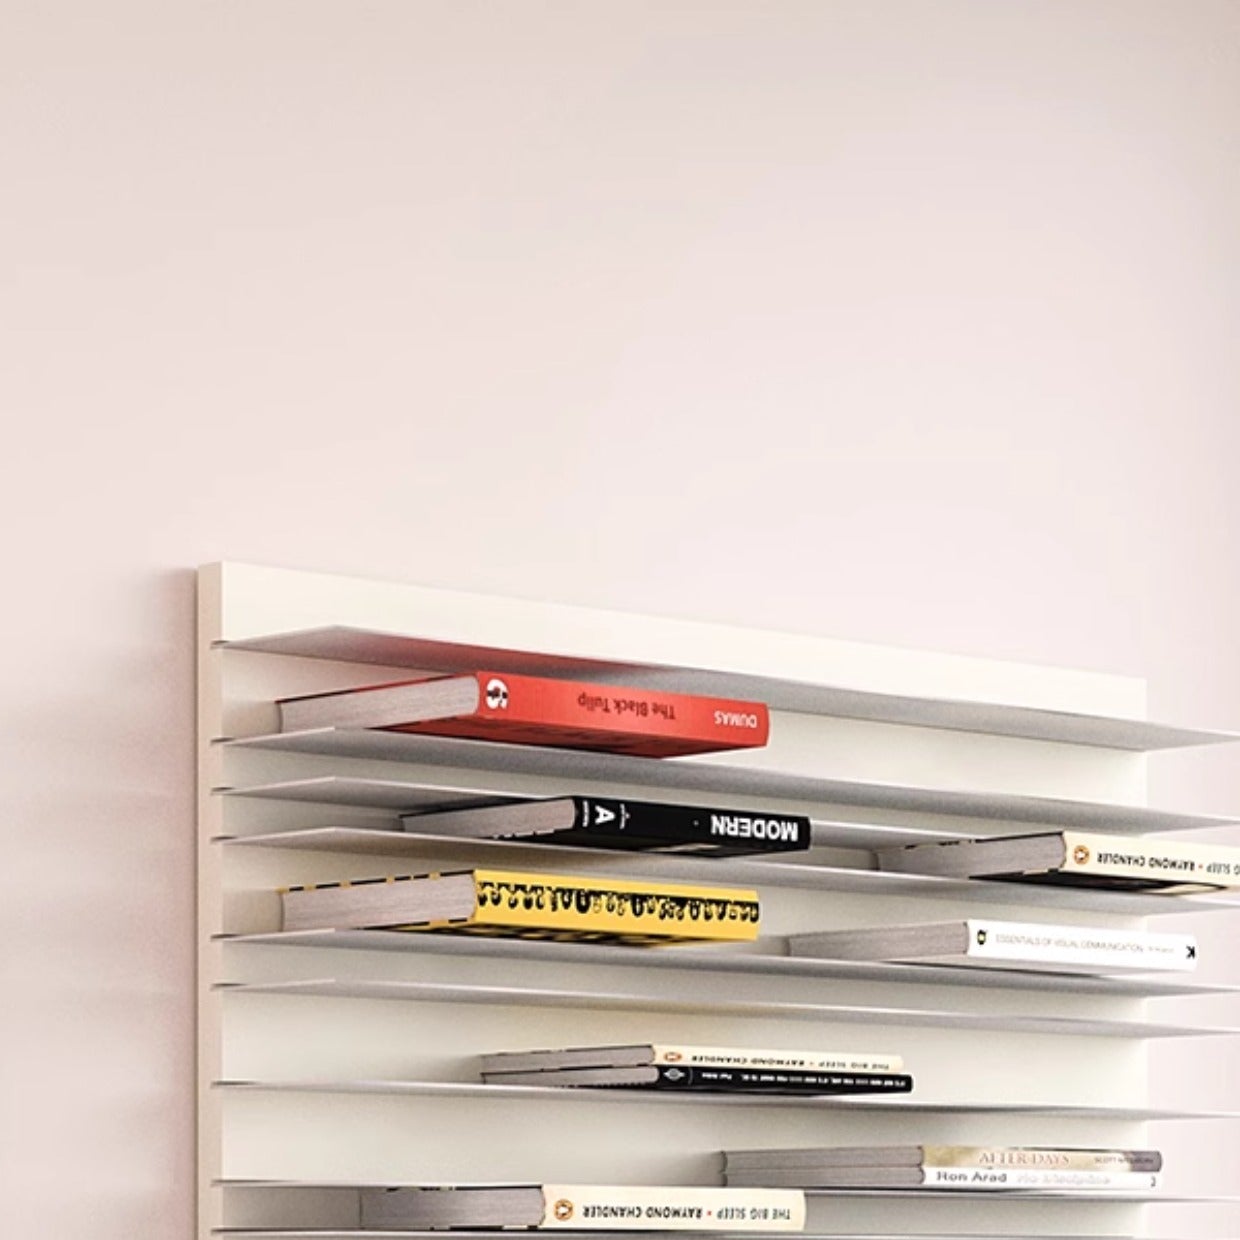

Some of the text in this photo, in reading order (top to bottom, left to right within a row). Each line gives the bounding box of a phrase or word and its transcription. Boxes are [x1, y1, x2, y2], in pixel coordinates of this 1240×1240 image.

[578, 692, 676, 720] The Black Tulip
[714, 710, 758, 728] DUMAS
[595, 805, 615, 825] A
[711, 815, 798, 841] MODERN
[1096, 852, 1145, 868] CHANDLER
[1148, 857, 1196, 872] RAYMOND
[1186, 946, 1195, 959] K
[691, 1055, 747, 1065] CHANDLER
[749, 1057, 805, 1067] RAYMOND
[979, 1152, 1029, 1164] AFTER
[1032, 1153, 1070, 1165] DAYS
[972, 1171, 1007, 1183] Arad
[582, 1205, 790, 1220] THE BIG SLEEP RAYMOND CHANDLER
